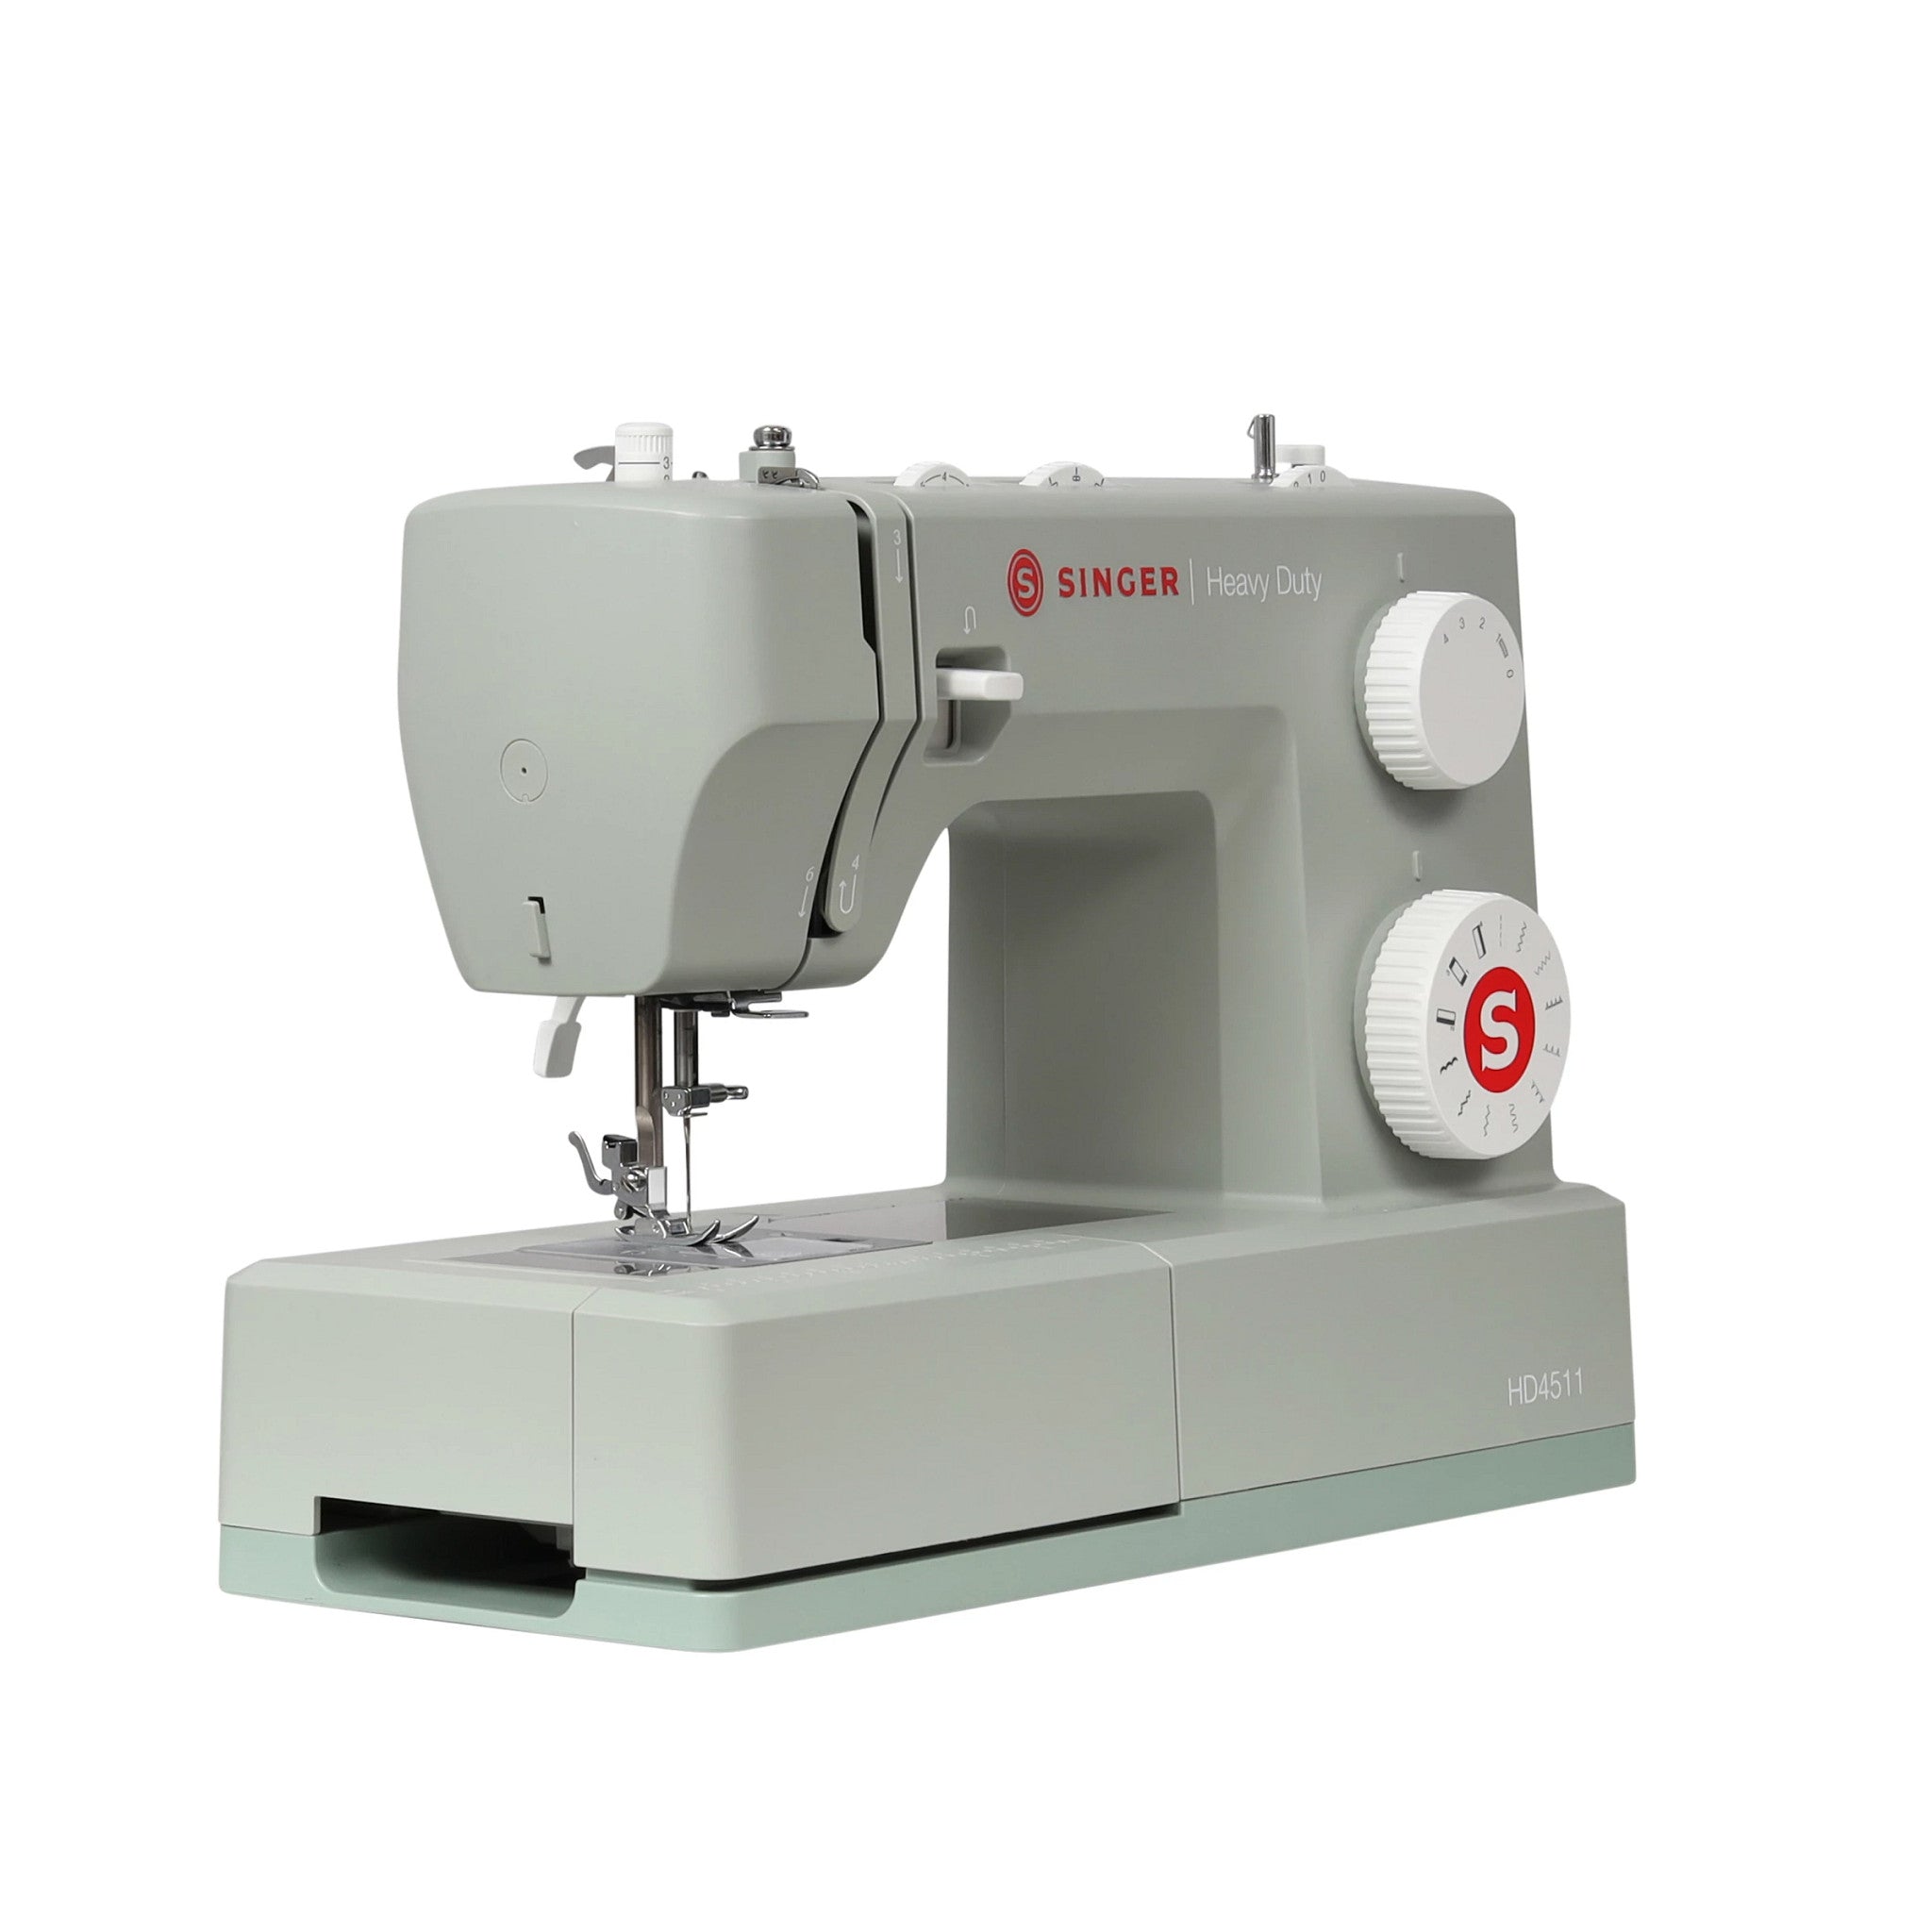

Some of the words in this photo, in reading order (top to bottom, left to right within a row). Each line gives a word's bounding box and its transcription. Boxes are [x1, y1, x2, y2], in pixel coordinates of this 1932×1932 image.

[663, 456, 670, 470] 3
[1320, 470, 1325, 482] 0
[893, 528, 901, 545] 3
[1058, 566, 1179, 598] SINGER
[1207, 566, 1270, 602] Heavy
[1275, 565, 1322, 601] Duty
[1458, 616, 1465, 629] 3
[1478, 616, 1486, 629] 2
[851, 854, 859, 870] 4
[806, 866, 814, 882] 6
[1479, 989, 1520, 1072] S
[1508, 1367, 1582, 1407] HD4511
